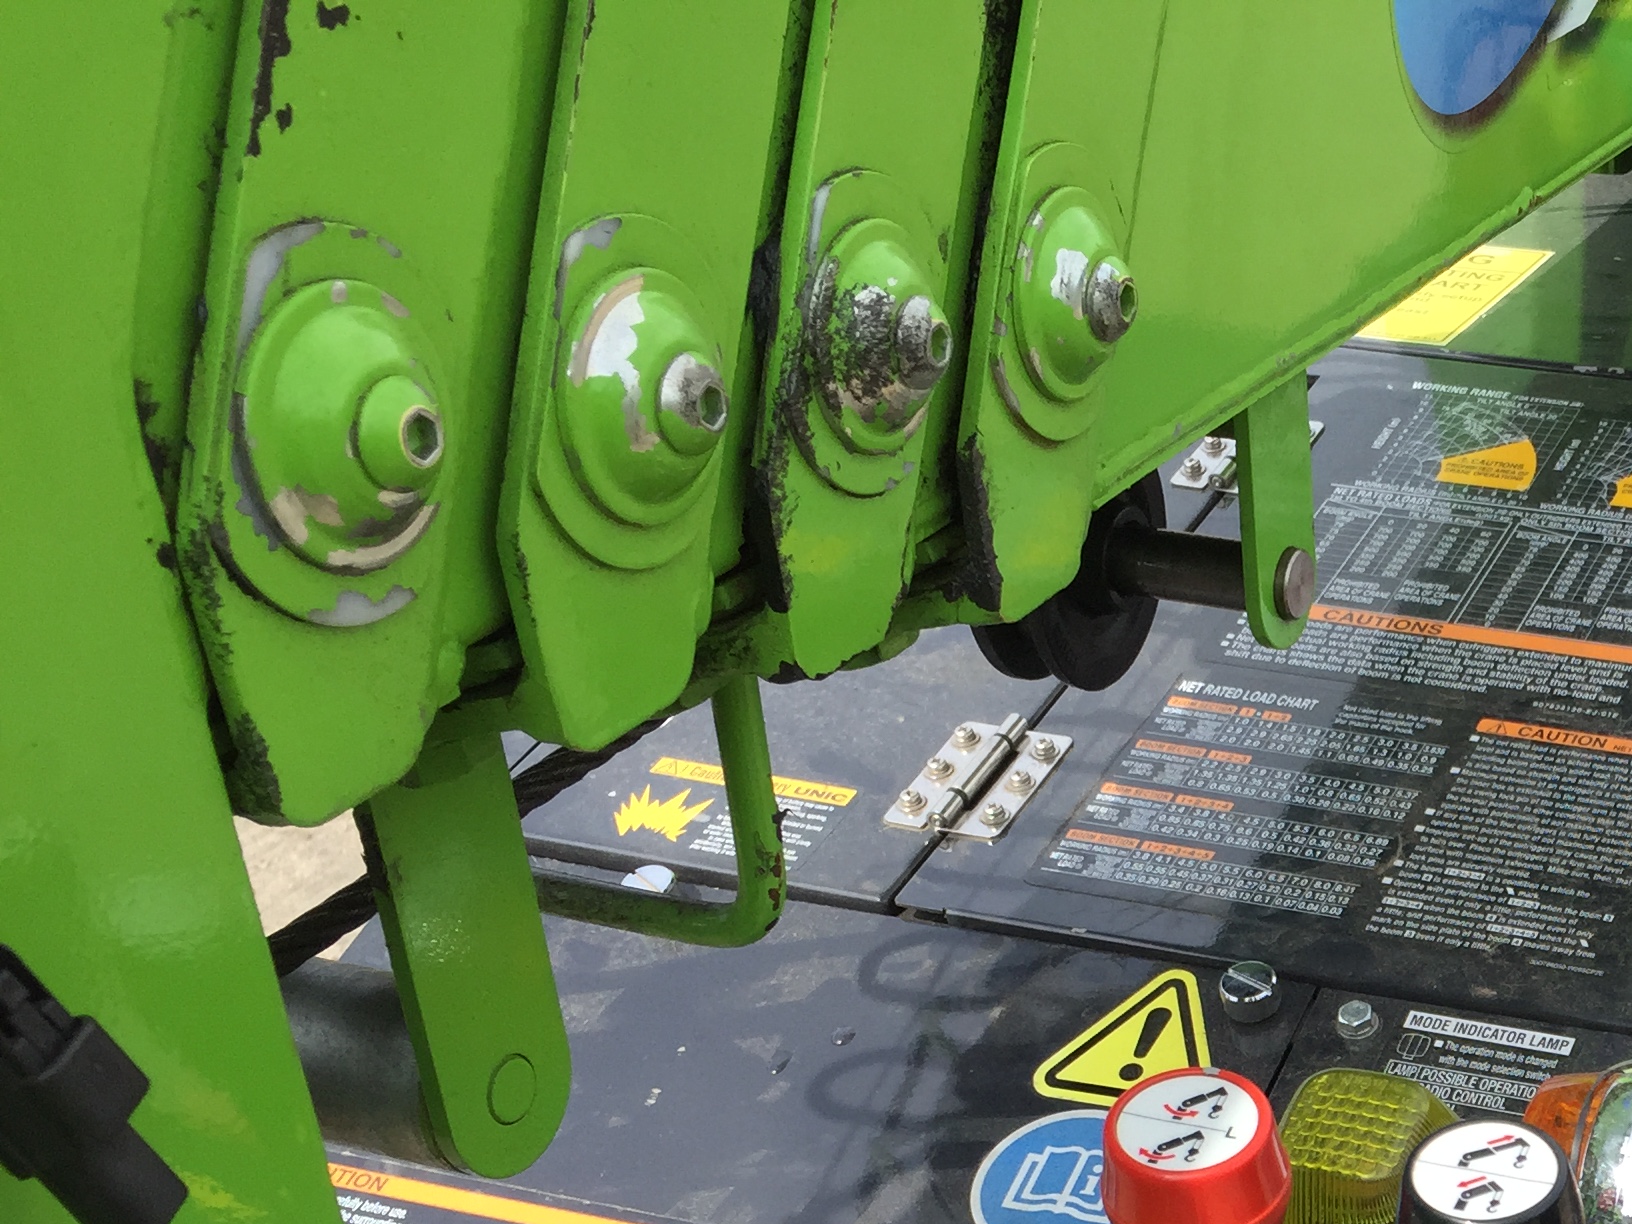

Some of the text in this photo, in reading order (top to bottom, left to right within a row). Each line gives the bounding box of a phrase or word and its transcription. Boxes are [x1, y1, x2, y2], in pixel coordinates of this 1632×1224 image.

[1448, 270, 1505, 281] TING
[1412, 382, 1511, 398] WORKING RANGE
[1470, 458, 1524, 470] CAUTIONS
[1323, 610, 1444, 635] CAUTIONS
[1176, 680, 1320, 711] NET RATED LOAD CHART
[1517, 726, 1608, 748] CAUTION
[794, 788, 847, 802] UNIC
[1410, 1015, 1570, 1050] MODE INDICATOR LAMP
[1445, 1041, 1559, 1069] The operation changed
[1388, 1063, 1536, 1099] LAMP POSSIBLE OPERATIO
[1452, 1089, 1506, 1110] CONTROL
[330, 1169, 389, 1192] TION
